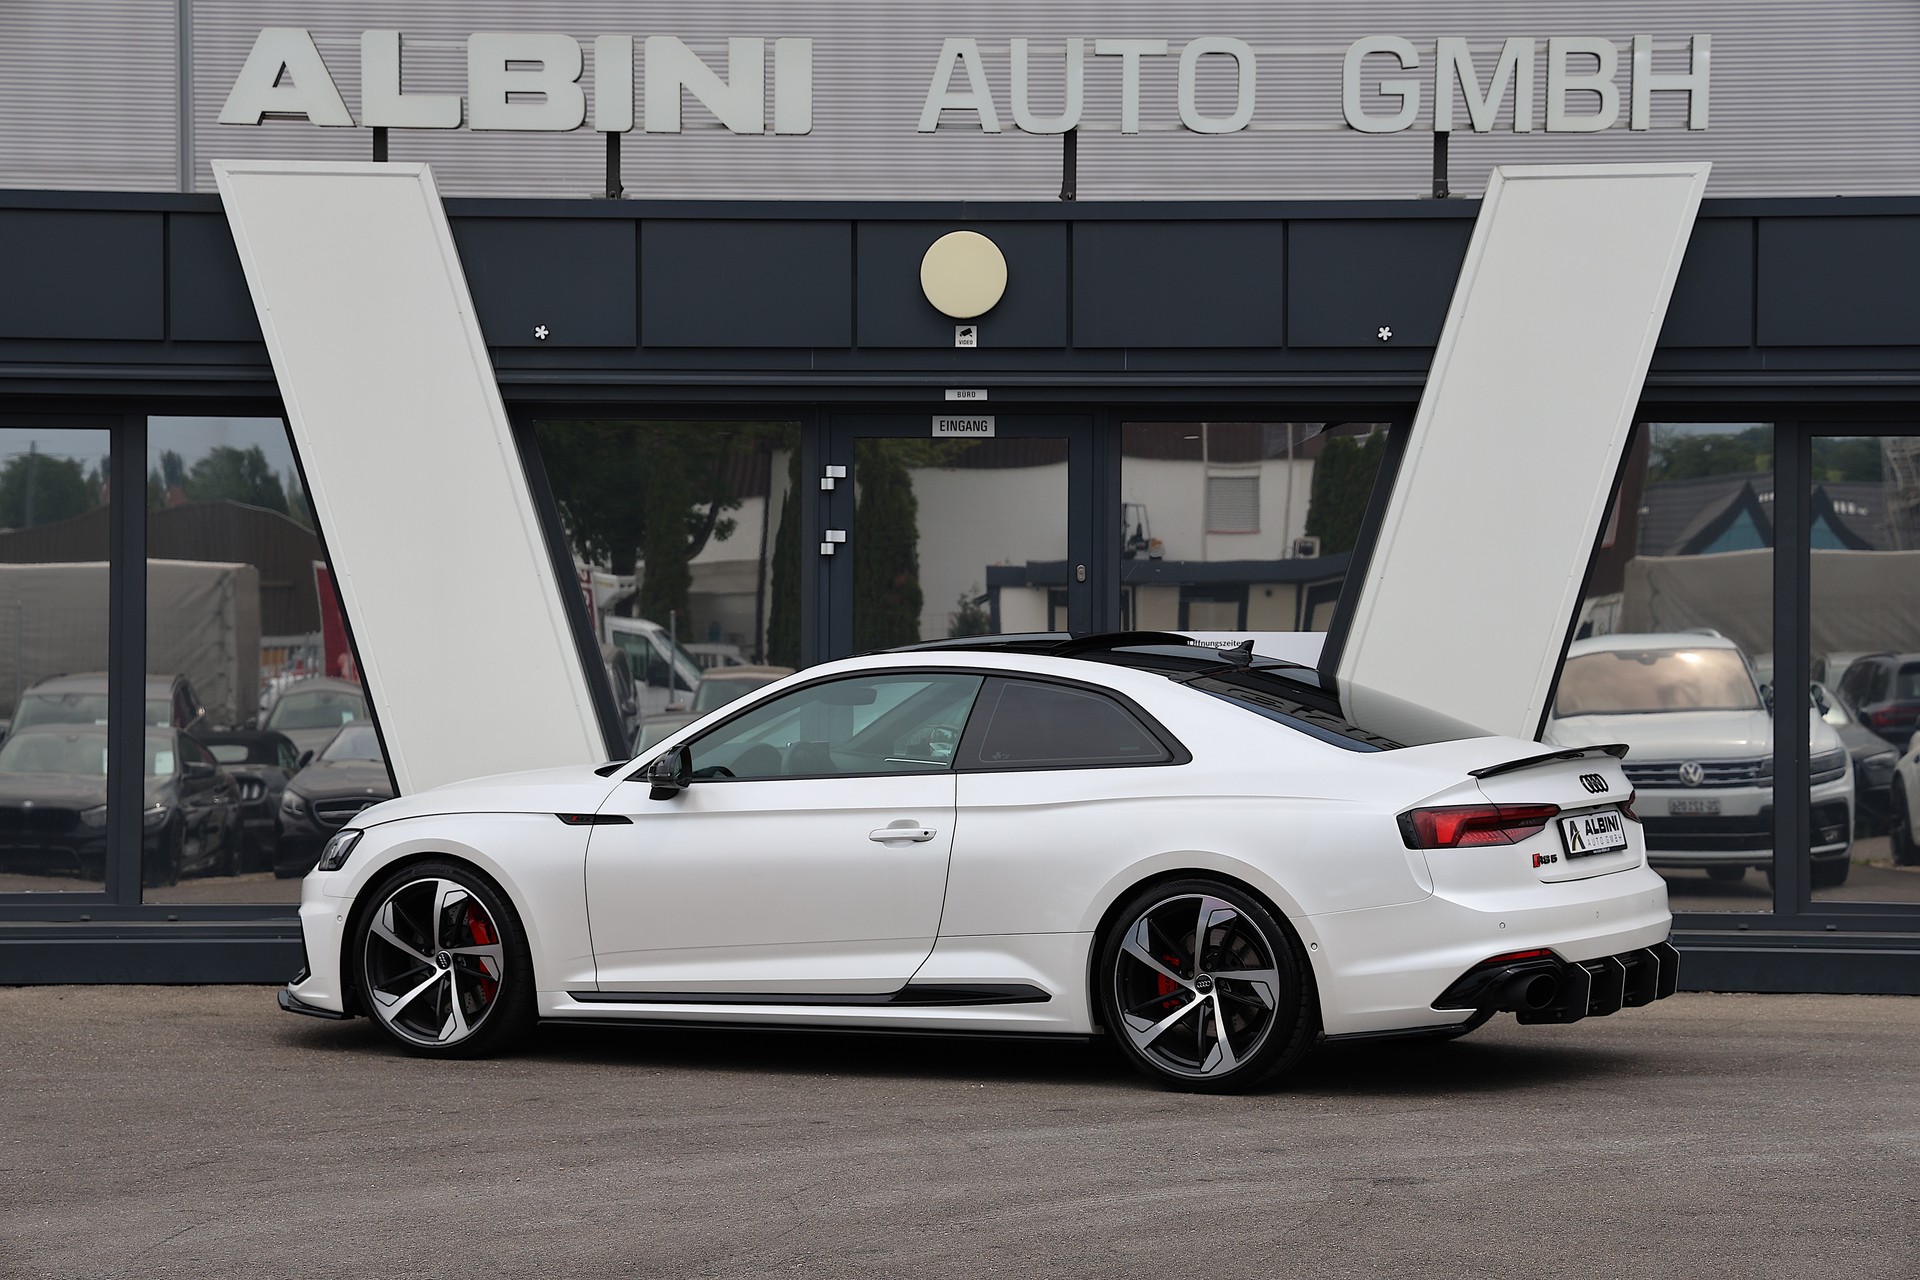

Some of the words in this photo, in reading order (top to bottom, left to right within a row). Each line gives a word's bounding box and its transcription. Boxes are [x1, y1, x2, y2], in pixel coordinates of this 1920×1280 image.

[217, 28, 814, 136] ALBINI
[917, 36, 1257, 135] AUTO
[1341, 33, 1712, 135] GMBH
[956, 389, 976, 398] BÜRO
[939, 419, 988, 432] EINGANG
[1585, 815, 1620, 836] ALBINI
[1587, 836, 1604, 847] AUTO
[1605, 834, 1623, 845] GMBH
